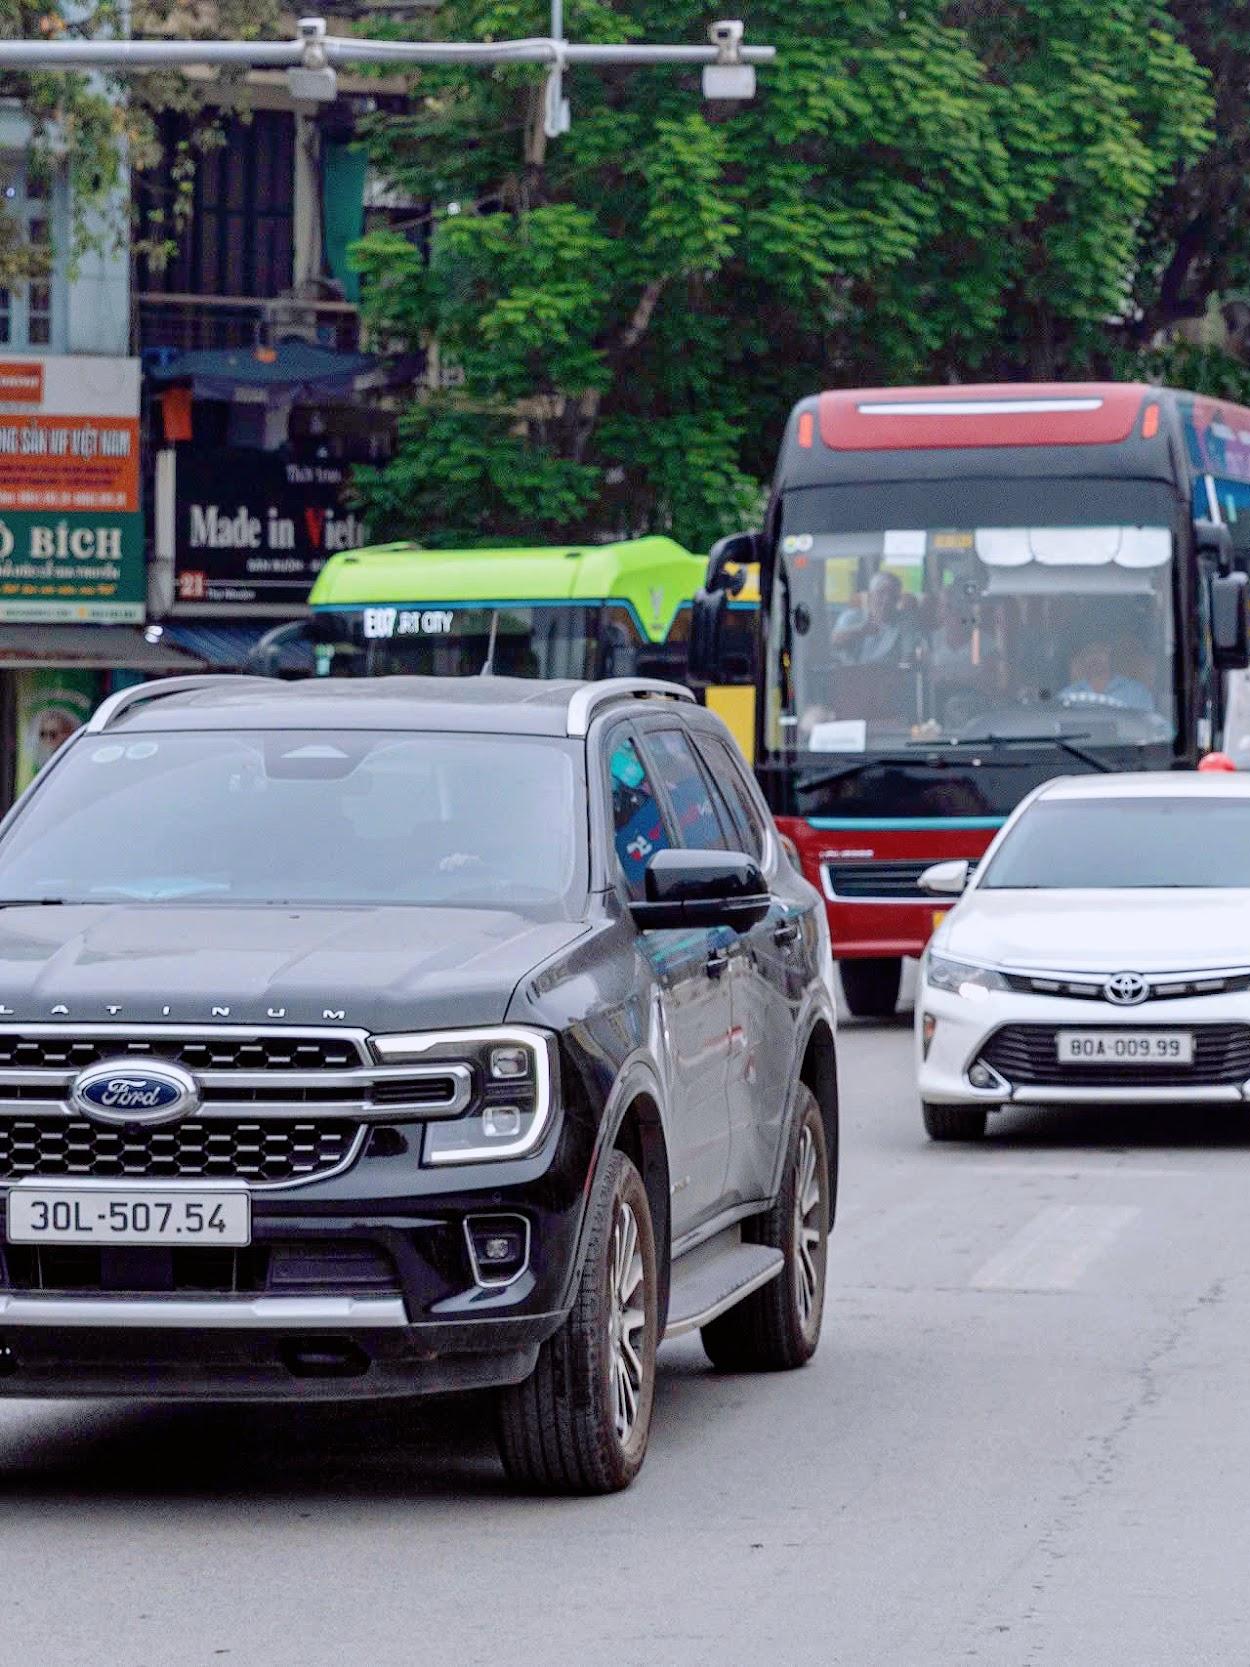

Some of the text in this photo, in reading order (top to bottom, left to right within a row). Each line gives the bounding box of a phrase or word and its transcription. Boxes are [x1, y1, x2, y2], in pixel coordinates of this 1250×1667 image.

[30, 520, 121, 559] BÍCH
[190, 504, 261, 548] Made
[268, 506, 295, 549] in
[421, 610, 453, 633] CITY
[1071, 1039, 1181, 1057] 80A-009.99
[100, 1079, 160, 1107] Ford
[30, 1201, 227, 1234] 30L-507.54
